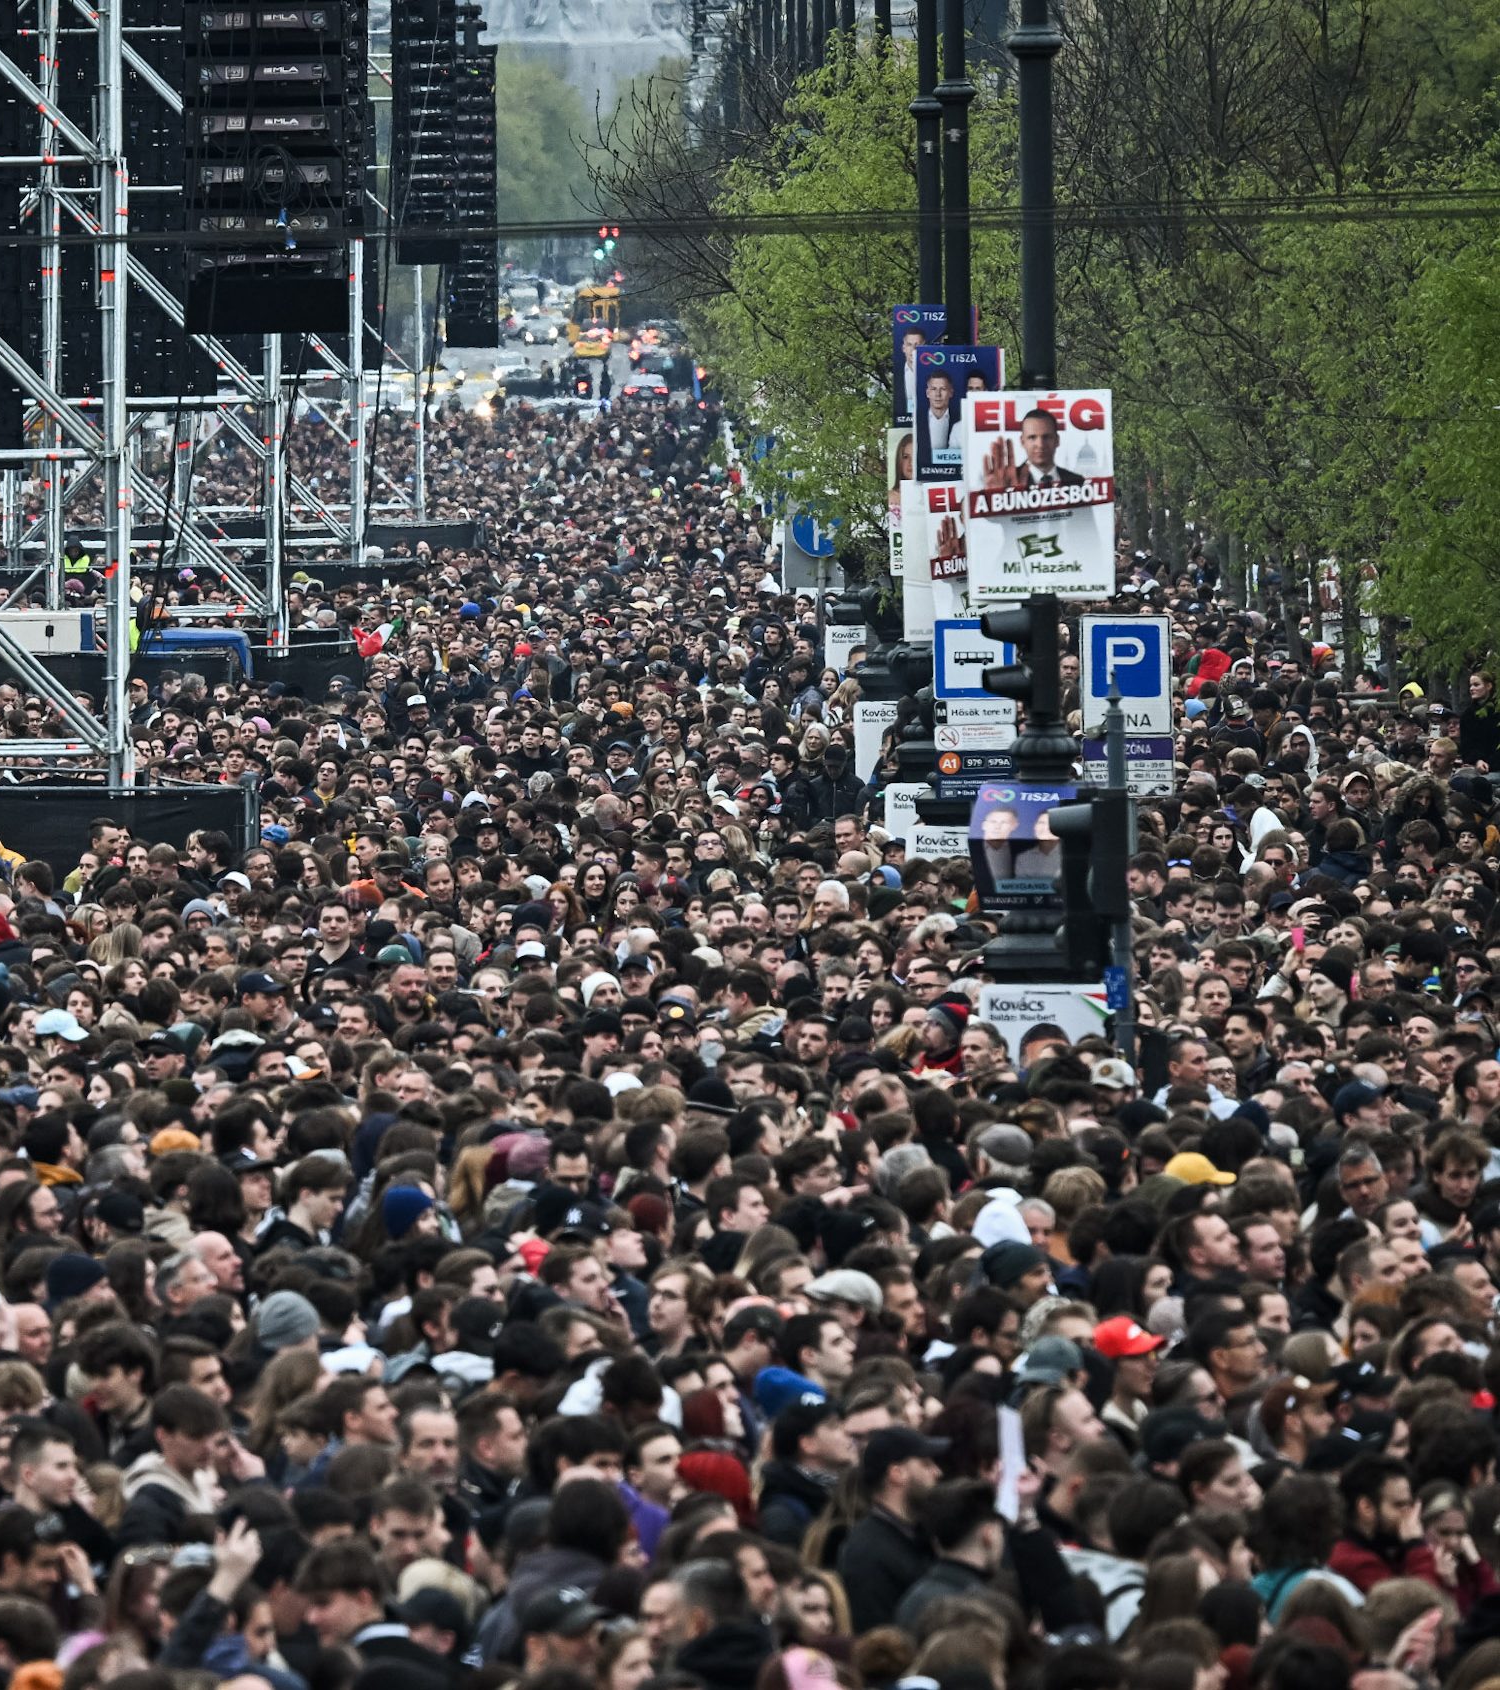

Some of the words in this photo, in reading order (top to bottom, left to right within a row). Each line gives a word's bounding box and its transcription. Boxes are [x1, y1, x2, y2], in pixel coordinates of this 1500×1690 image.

[272, 13, 298, 21] MLA
[272, 66, 299, 75] MLA
[273, 118, 299, 126] MLA
[923, 312, 946, 321] TISZ
[950, 354, 977, 363] TISZA
[975, 393, 1105, 432] ELÉG
[928, 487, 961, 513] EL
[974, 494, 989, 514] A
[991, 479, 1109, 512] BŰNÖZÉSBŐL!
[934, 563, 943, 577] A
[944, 555, 967, 575] BŰN
[1003, 562, 1021, 574] Mi
[1030, 560, 1082, 574] Hazánk
[832, 630, 861, 639] Kovács
[1106, 636, 1145, 685] P
[861, 708, 897, 718] Kovács
[983, 708, 1000, 716] tere
[942, 759, 957, 769] A1
[967, 759, 983, 767] 979
[1020, 791, 1060, 802] TISZA
[916, 834, 959, 847] Kovács
[989, 997, 1045, 1012] Kovács
